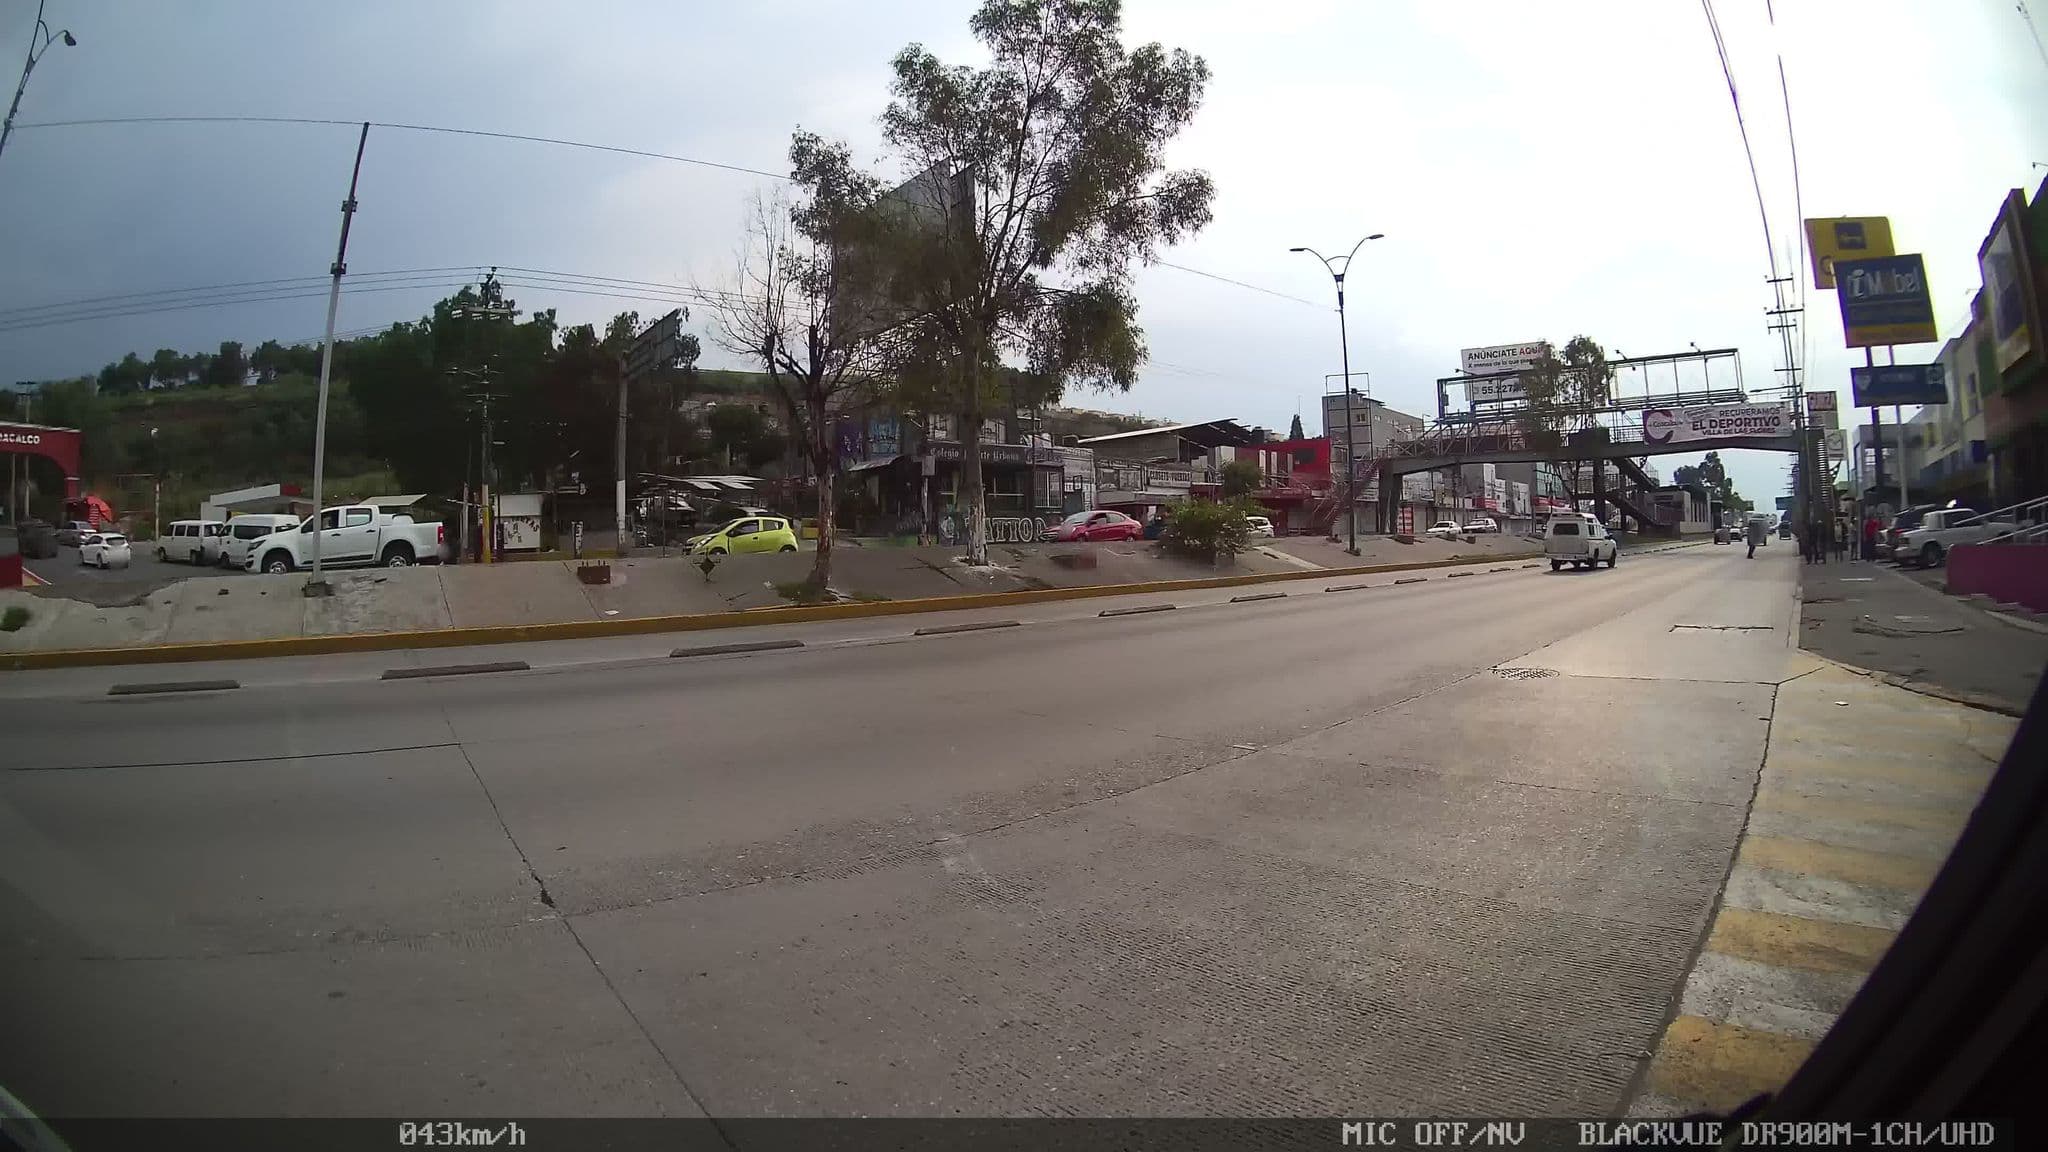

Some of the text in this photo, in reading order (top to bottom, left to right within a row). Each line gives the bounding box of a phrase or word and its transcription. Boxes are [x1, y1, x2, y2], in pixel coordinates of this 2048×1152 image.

[1719, 407, 1781, 417] RECUPERAMOS
[1692, 416, 1781, 431] EL DEPORTIVO
